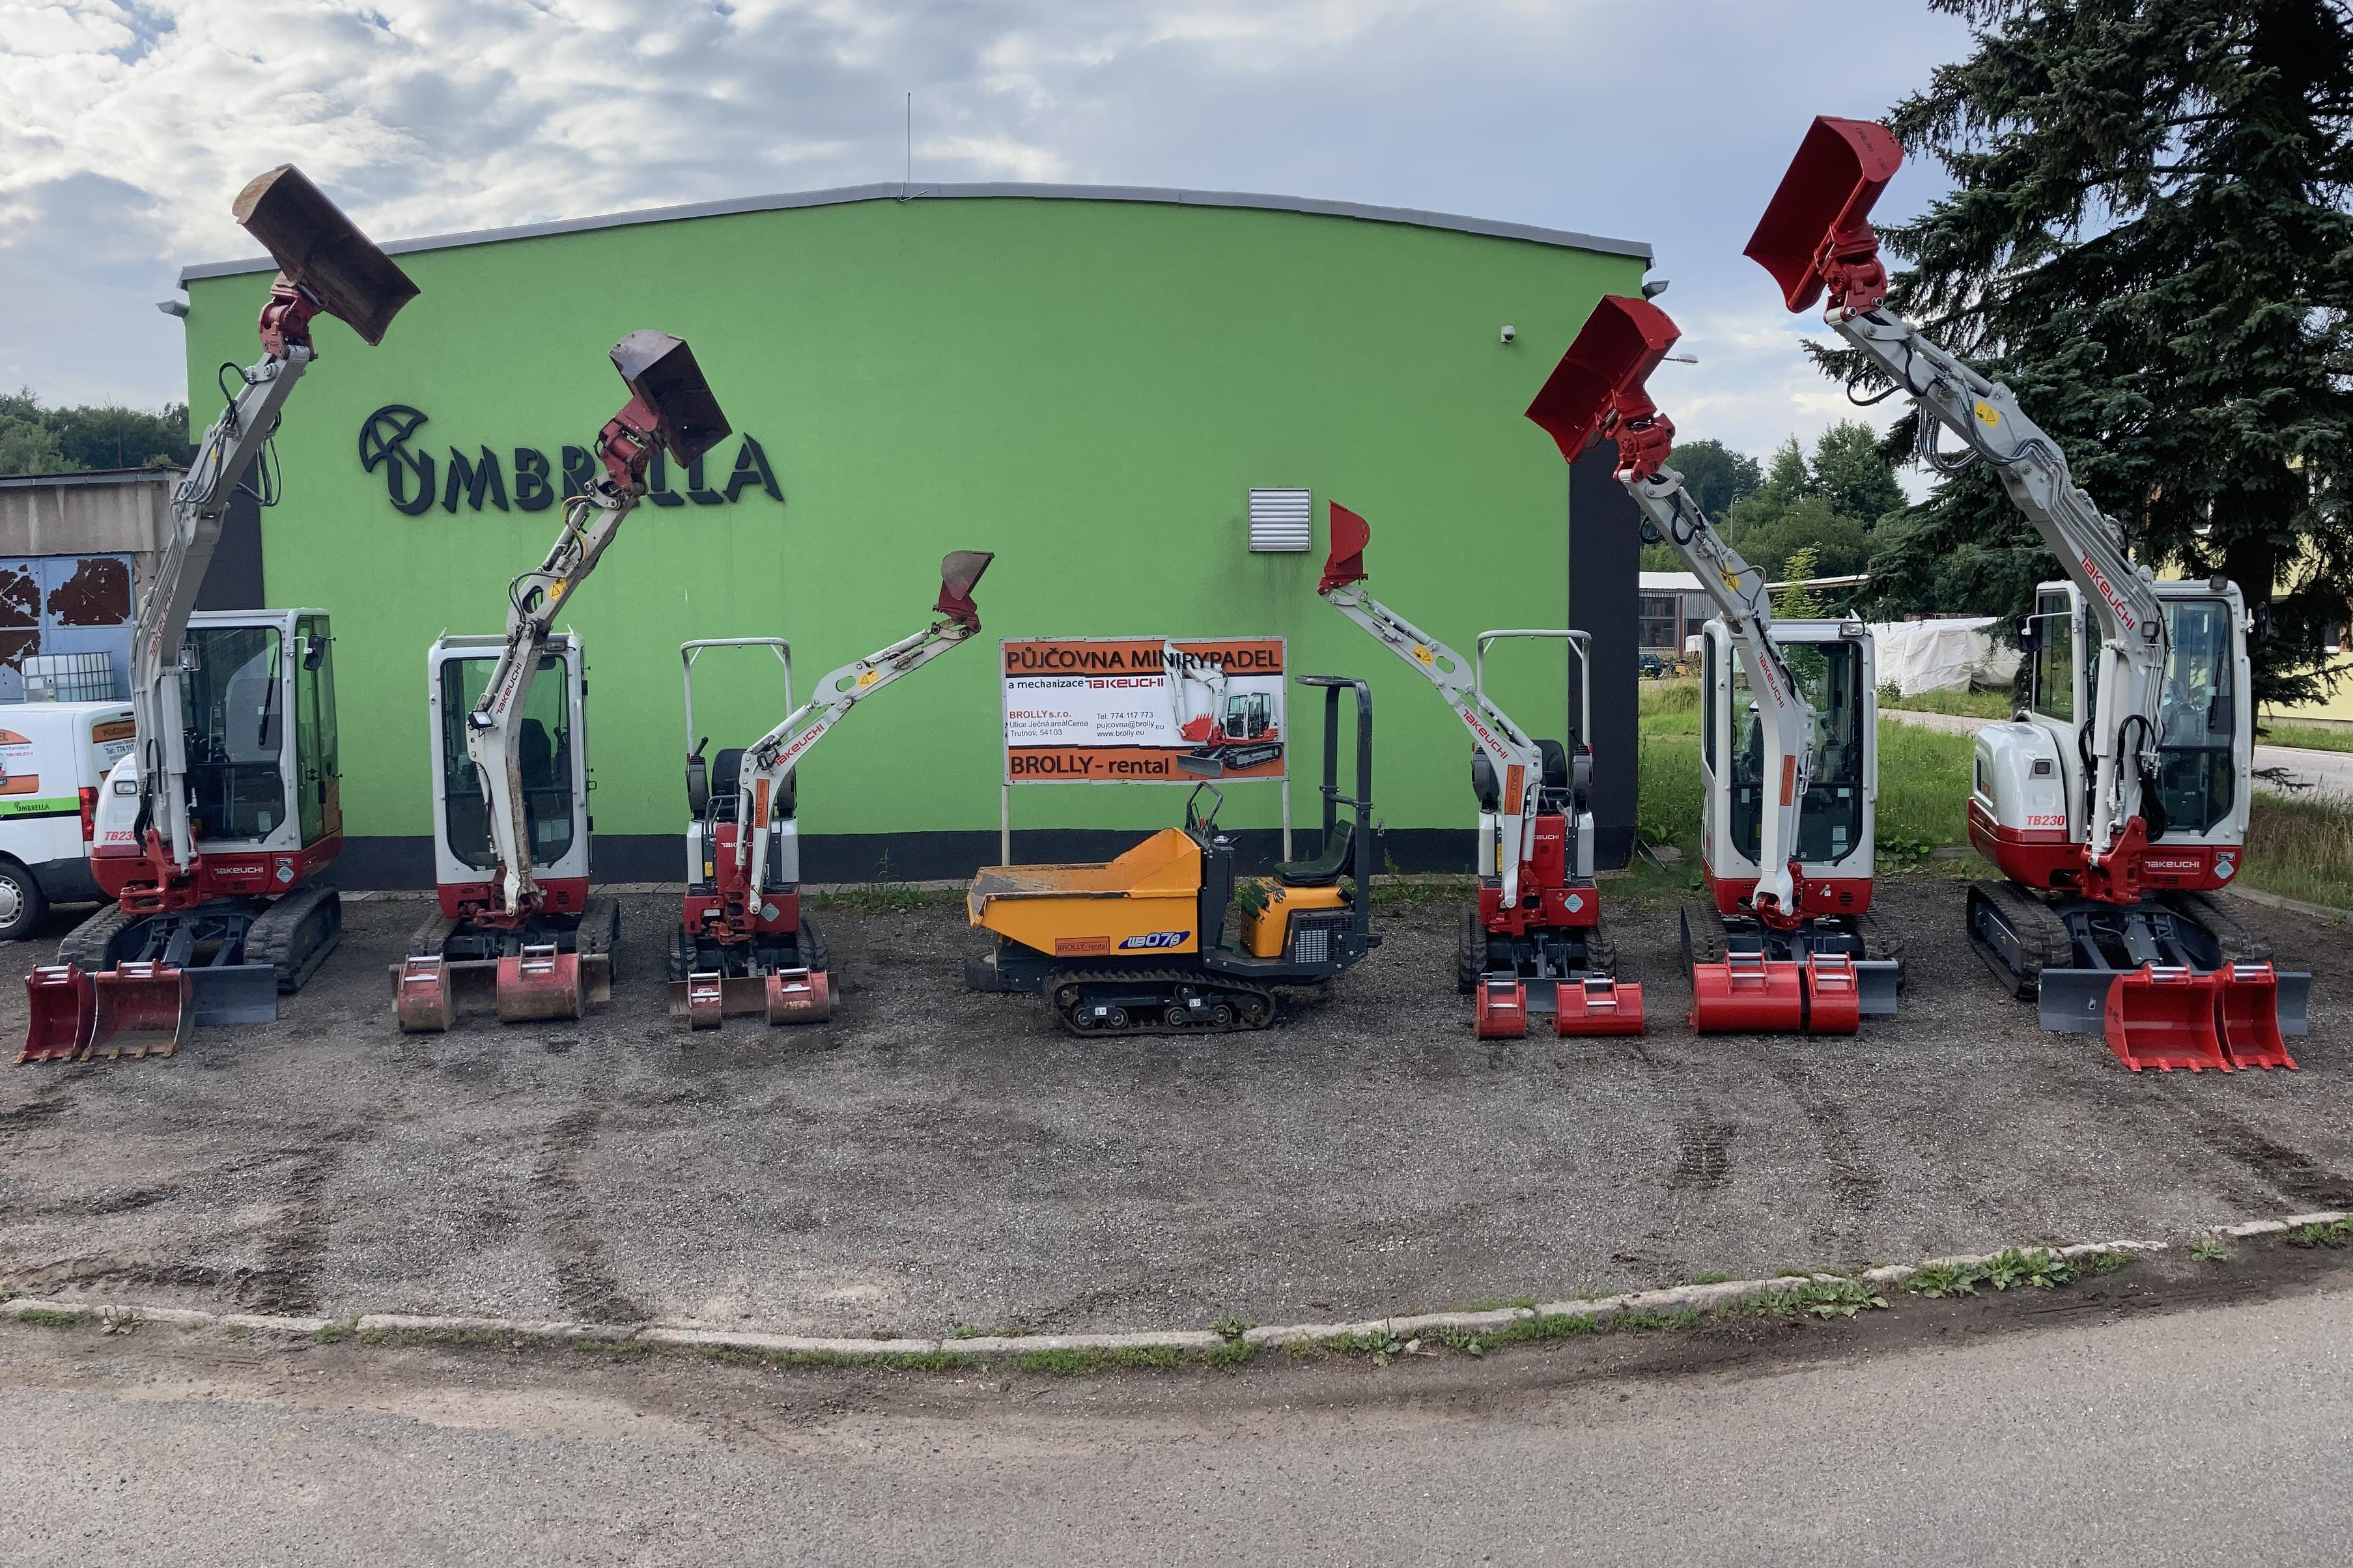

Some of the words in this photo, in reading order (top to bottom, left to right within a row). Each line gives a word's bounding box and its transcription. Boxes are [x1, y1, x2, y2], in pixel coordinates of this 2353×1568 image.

[359, 405, 783, 515] UMBRLLA
[2081, 551, 2135, 631] TAKEUCHI
[1007, 647, 1125, 669] PŮJČOVNA
[1131, 650, 1280, 669] MINIRYPADEL
[496, 662, 522, 714] TAKEUCHI
[1017, 679, 1084, 688] mechanizace
[1085, 678, 1164, 689] TAKEUCHI
[1760, 651, 1784, 708] TAKEUCHI
[1009, 710, 1047, 719] BROLLY
[1097, 729, 1144, 738] www.brolly.eu
[1463, 708, 1508, 759] TAKEUCHI
[1011, 755, 1093, 774] BROLLY
[1108, 757, 1169, 775] rental
[14, 802, 50, 812] UMBRELLA
[2027, 815, 2065, 826] TB230
